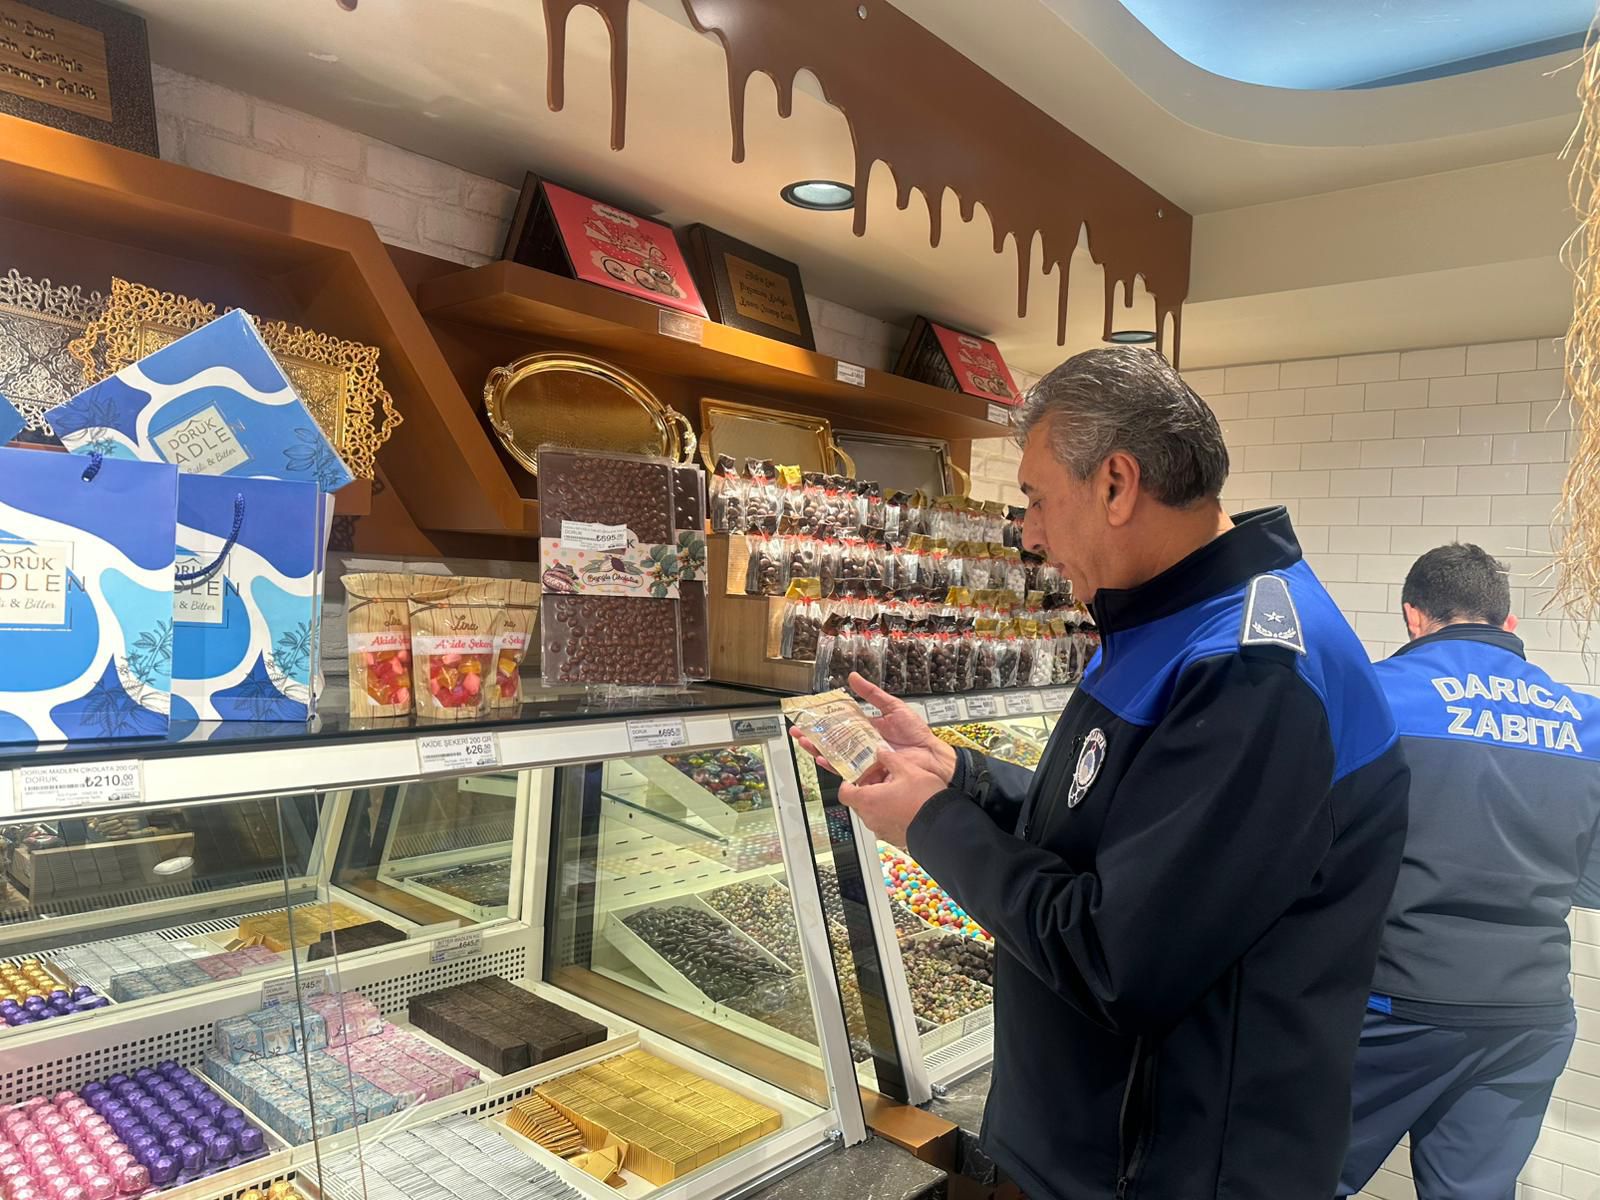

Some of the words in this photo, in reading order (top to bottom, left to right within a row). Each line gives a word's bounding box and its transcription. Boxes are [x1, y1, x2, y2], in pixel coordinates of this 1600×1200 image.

[168, 417, 217, 450] DORUK
[0, 555, 56, 571] ORUK
[0, 572, 86, 592] DLEN
[9, 598, 20, 609] &
[178, 600, 189, 609] &
[450, 614, 479, 631] Lina
[1431, 673, 1583, 721] DARICA
[1446, 705, 1583, 753] ZABITA
[469, 736, 481, 744] 200
[481, 735, 492, 743] GR
[49, 767, 79, 775] MADLEN
[25, 775, 59, 784] DORUK
